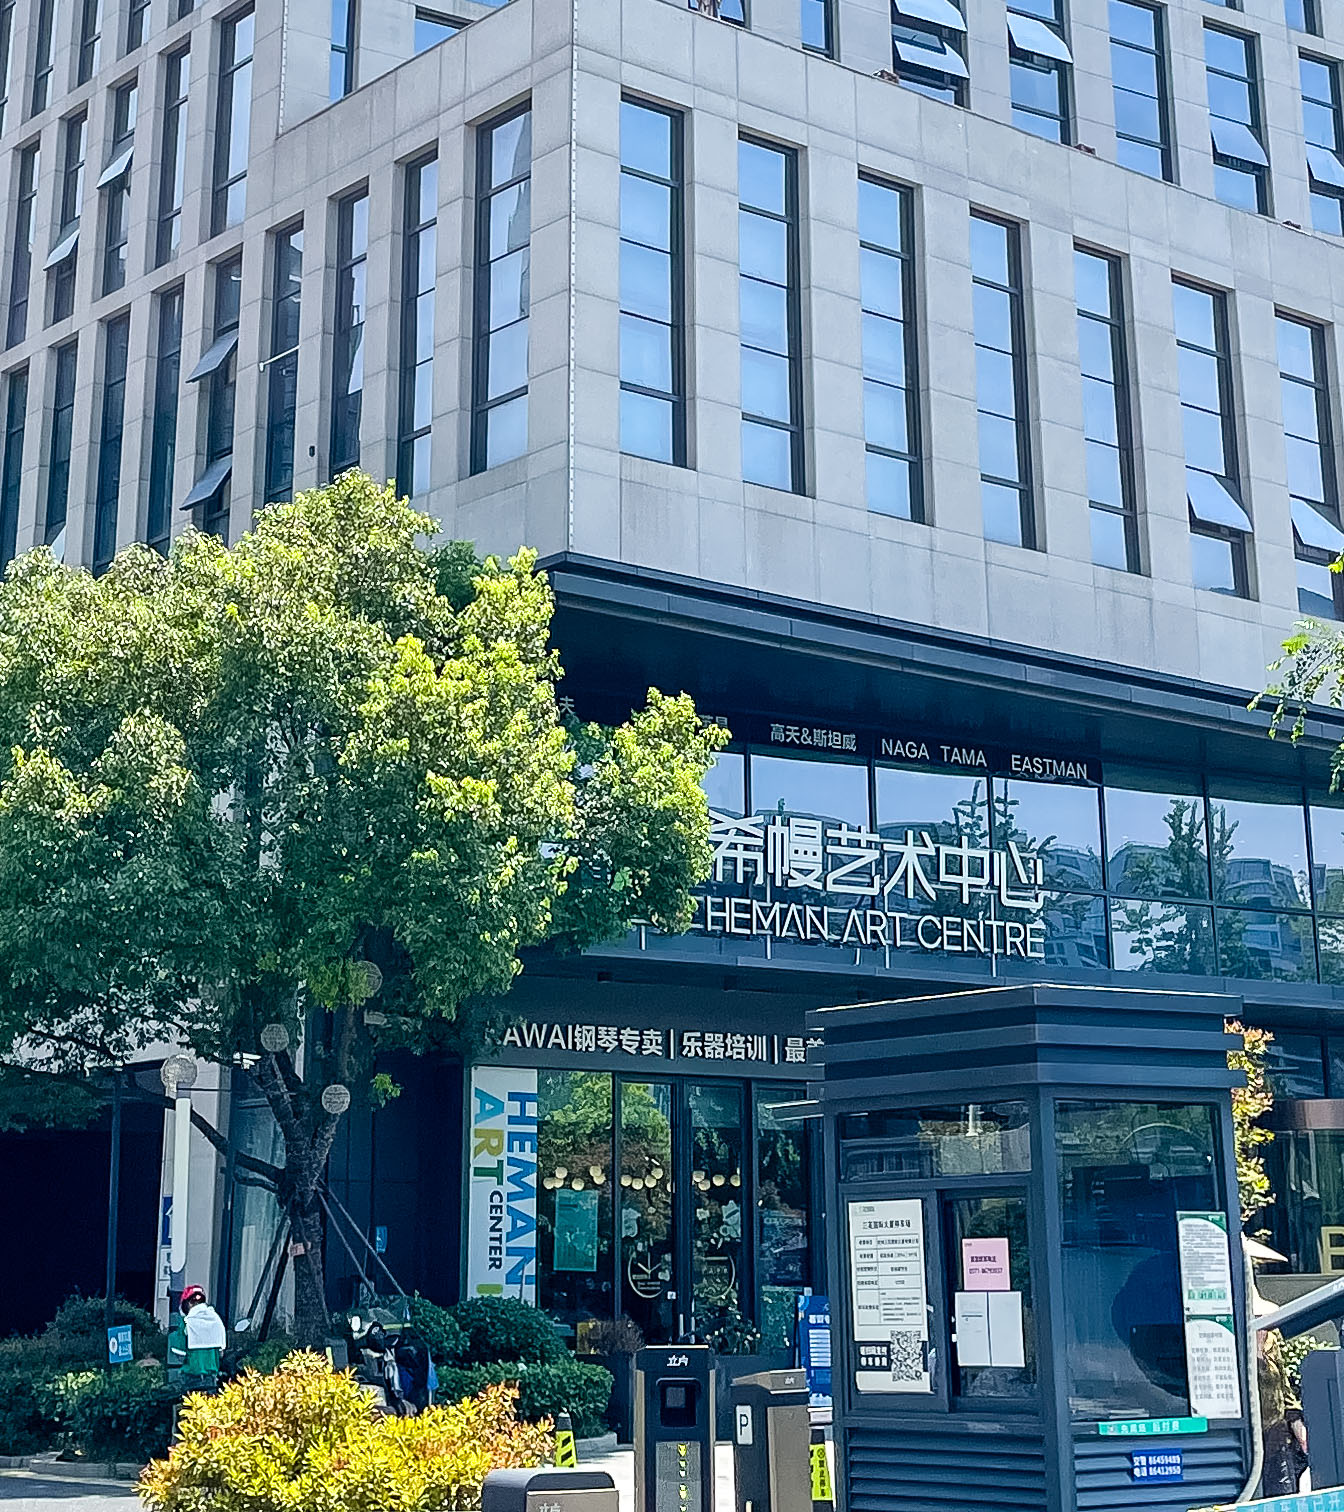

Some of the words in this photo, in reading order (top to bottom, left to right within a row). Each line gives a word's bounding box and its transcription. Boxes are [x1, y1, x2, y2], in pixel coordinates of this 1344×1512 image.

[881, 738, 930, 761] NAGA
[940, 745, 988, 768] TAMA
[1011, 754, 1088, 780] EASTMAN
[706, 895, 829, 941] HEMAN
[842, 908, 905, 948] ART
[917, 914, 1046, 958] CENTRE
[682, 1032, 767, 1061] 乐器培训
[473, 1088, 505, 1185] ART
[505, 1091, 538, 1285] HEMAN
[488, 1190, 504, 1272] CENTER
[739, 1413, 749, 1436] P
